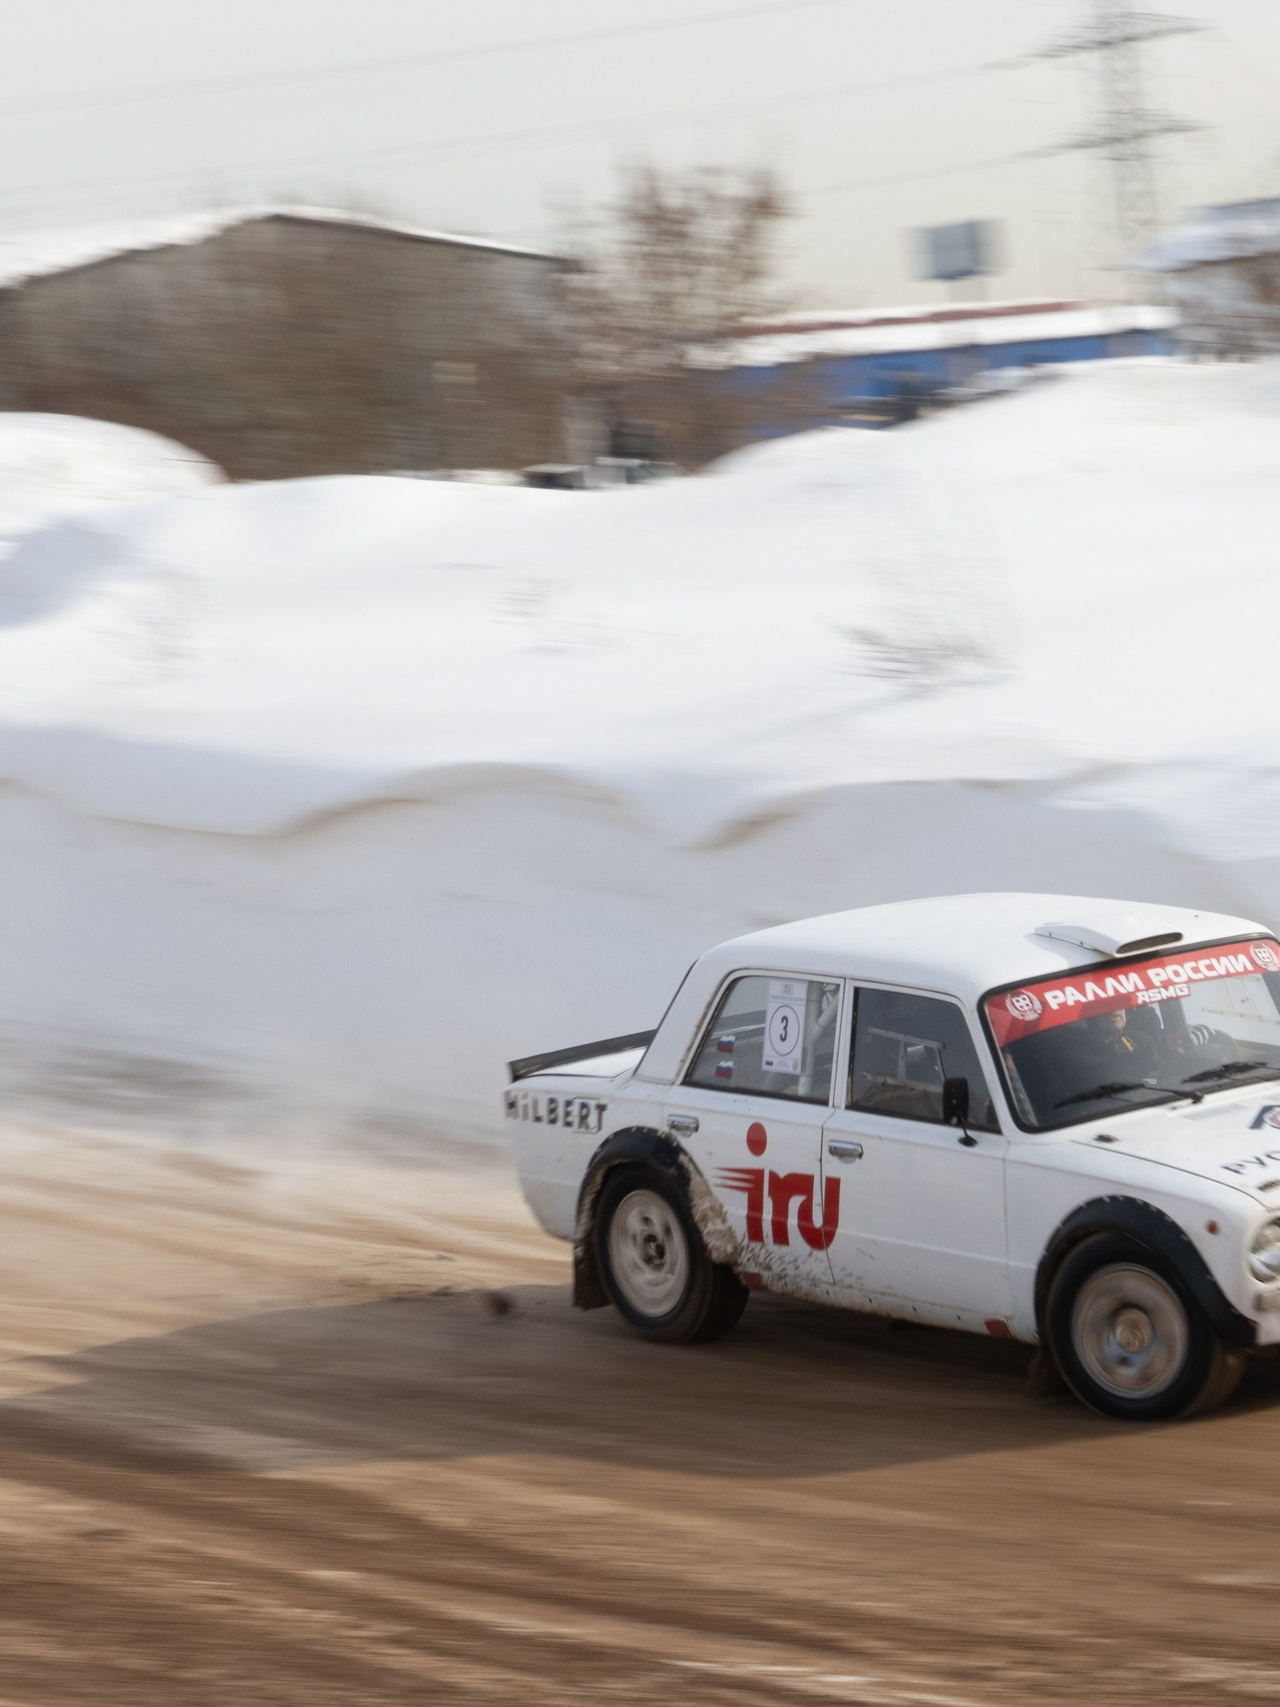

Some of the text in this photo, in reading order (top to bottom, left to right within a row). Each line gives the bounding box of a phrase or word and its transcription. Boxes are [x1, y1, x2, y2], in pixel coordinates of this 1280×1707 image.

[1043, 953, 1255, 1011] РАЛЛИ РОССИИ
[780, 1015, 789, 1042] 3
